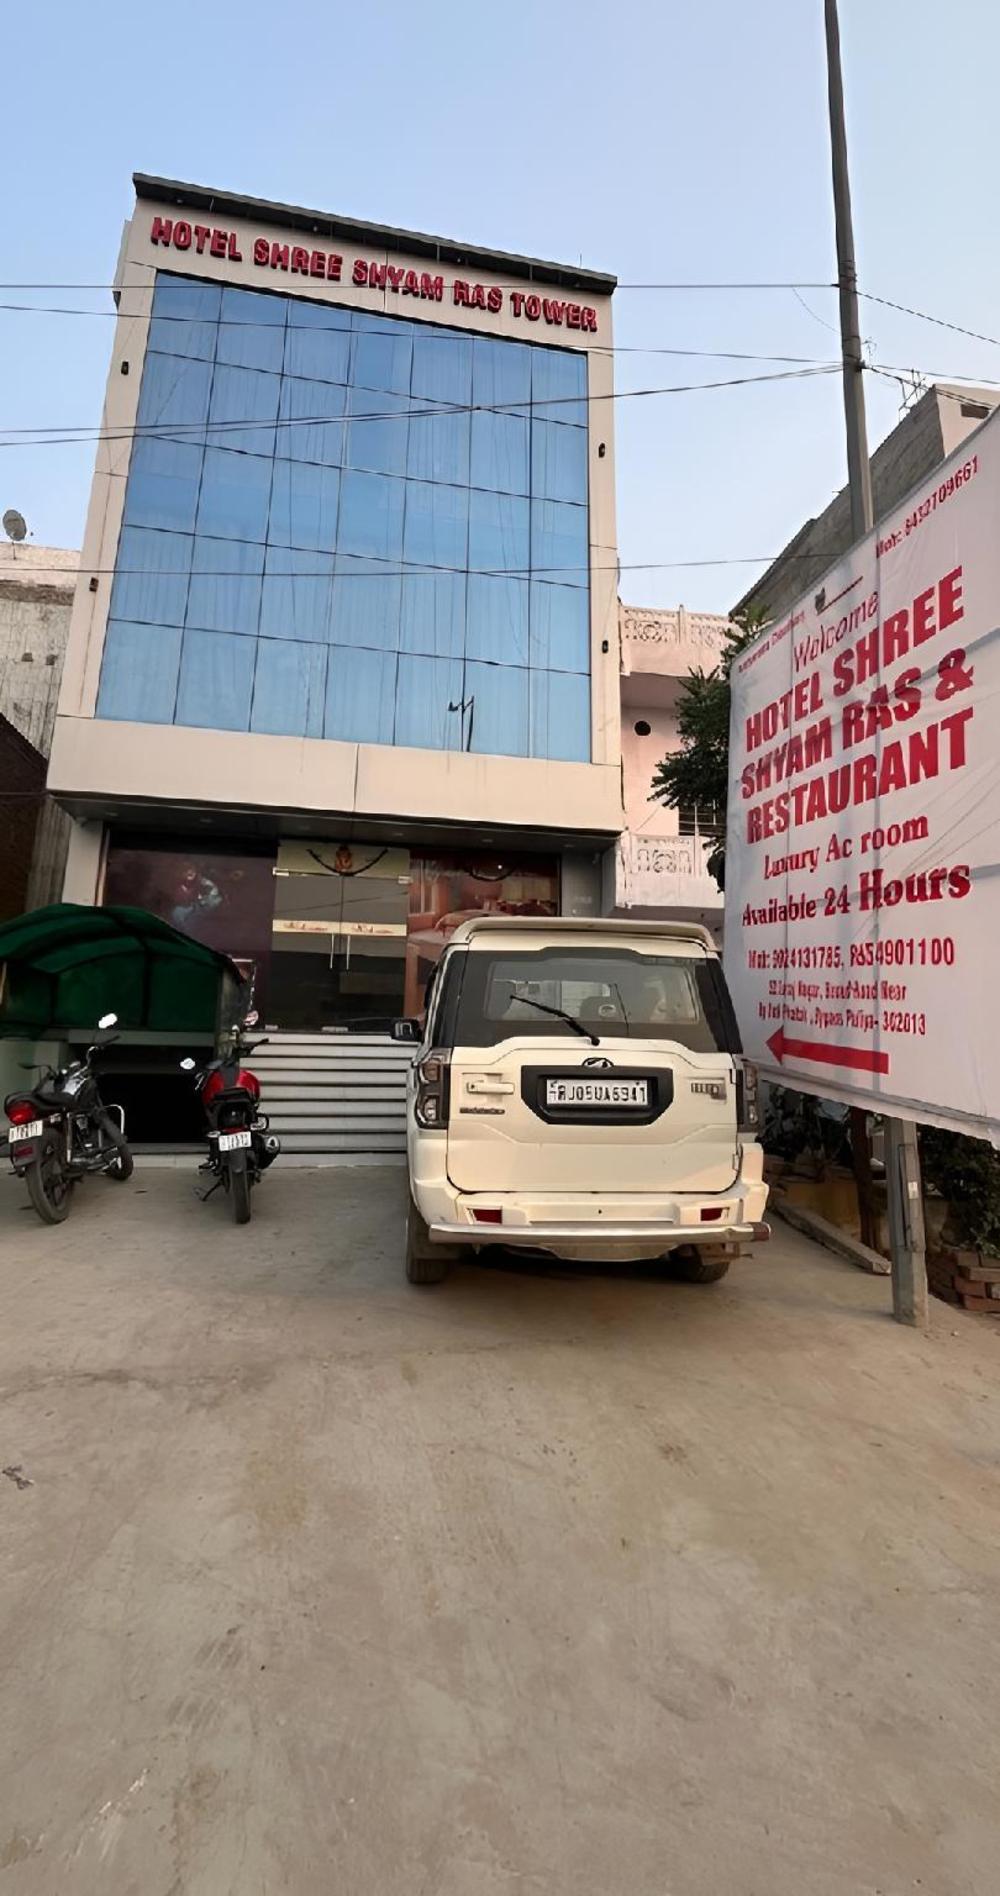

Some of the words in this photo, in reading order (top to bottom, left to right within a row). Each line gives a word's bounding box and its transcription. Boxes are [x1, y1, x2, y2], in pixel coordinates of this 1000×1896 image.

[150, 216, 242, 262] HOTEL
[254, 237, 343, 281] SHREE
[352, 259, 444, 303] SHYAM
[510, 291, 598, 333] TOWER
[746, 672, 823, 752] HOTEL
[833, 565, 964, 697] SHREE
[794, 591, 879, 673] Welcome
[741, 716, 833, 800] SHYAM
[842, 667, 922, 750] RAS
[935, 648, 974, 701] &
[746, 707, 974, 845] RESTAURANT
[742, 893, 817, 926] Available
[824, 887, 850, 917] 24
[858, 863, 971, 912] Hours
[764, 846, 821, 880] Luxury
[825, 833, 853, 863] Ac
[860, 815, 929, 854] room
